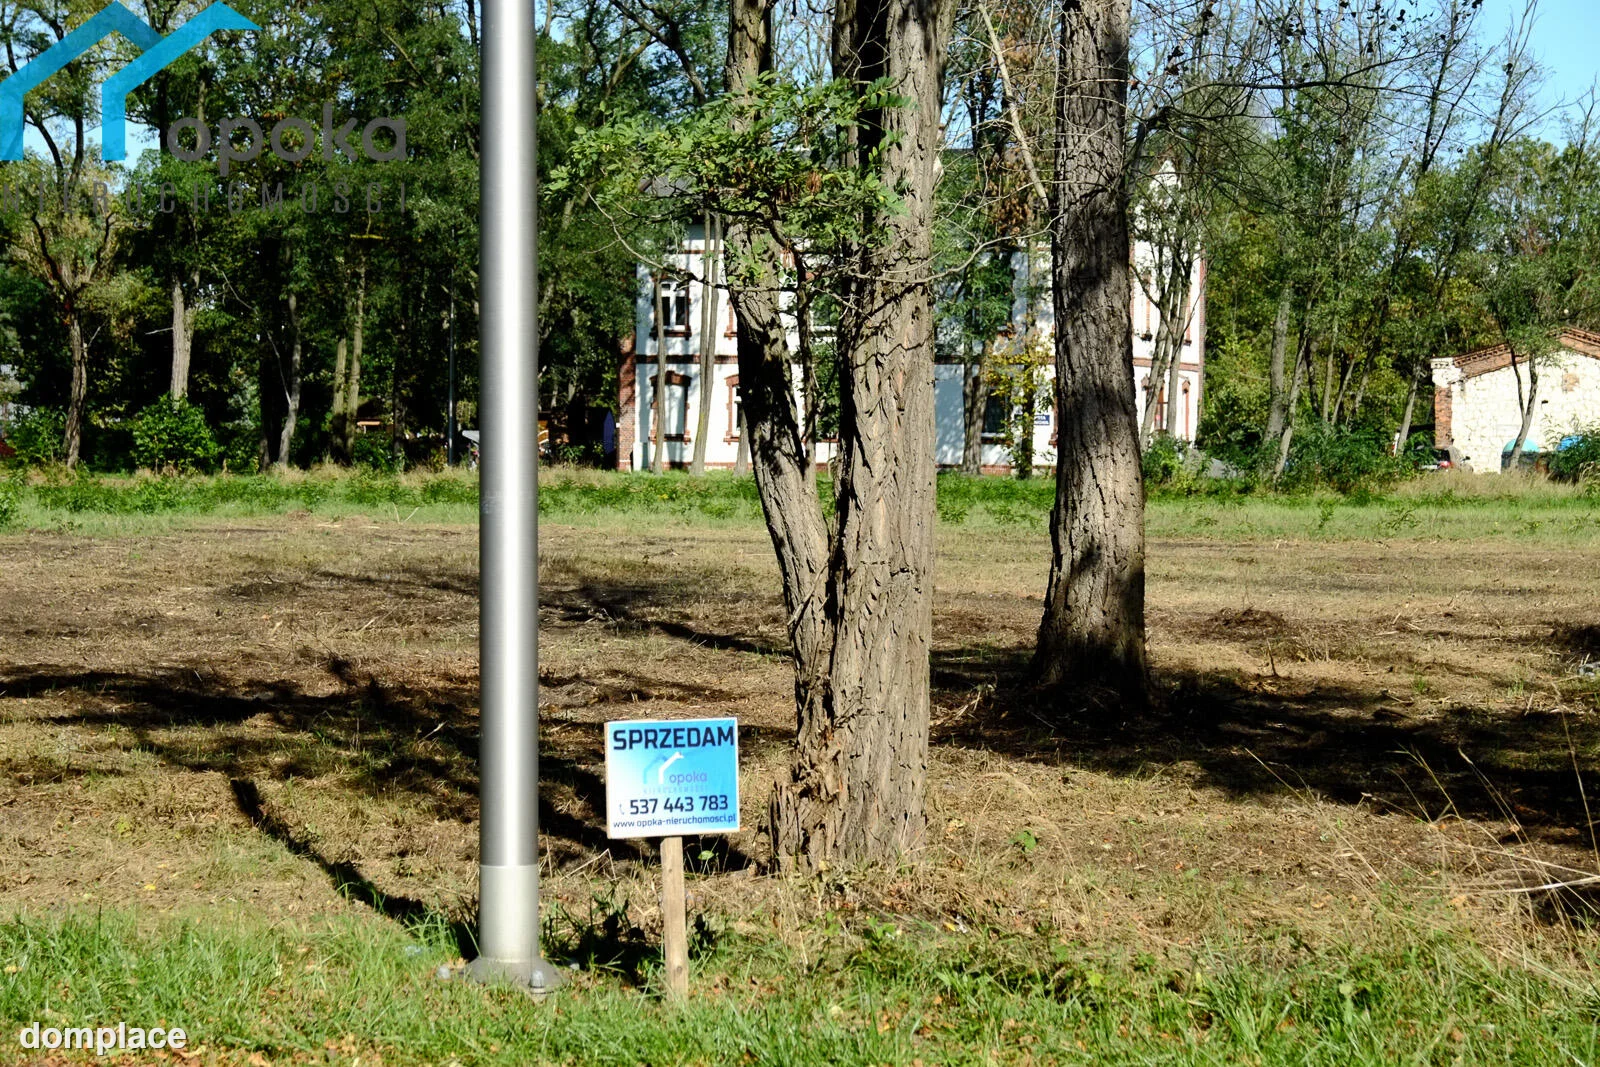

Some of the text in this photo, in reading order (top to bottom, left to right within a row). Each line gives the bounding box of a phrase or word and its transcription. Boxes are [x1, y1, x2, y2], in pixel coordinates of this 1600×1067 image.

[613, 726, 735, 750] SPRZEDAM
[669, 771, 708, 785] opoka
[629, 794, 728, 815] 537 443 783
